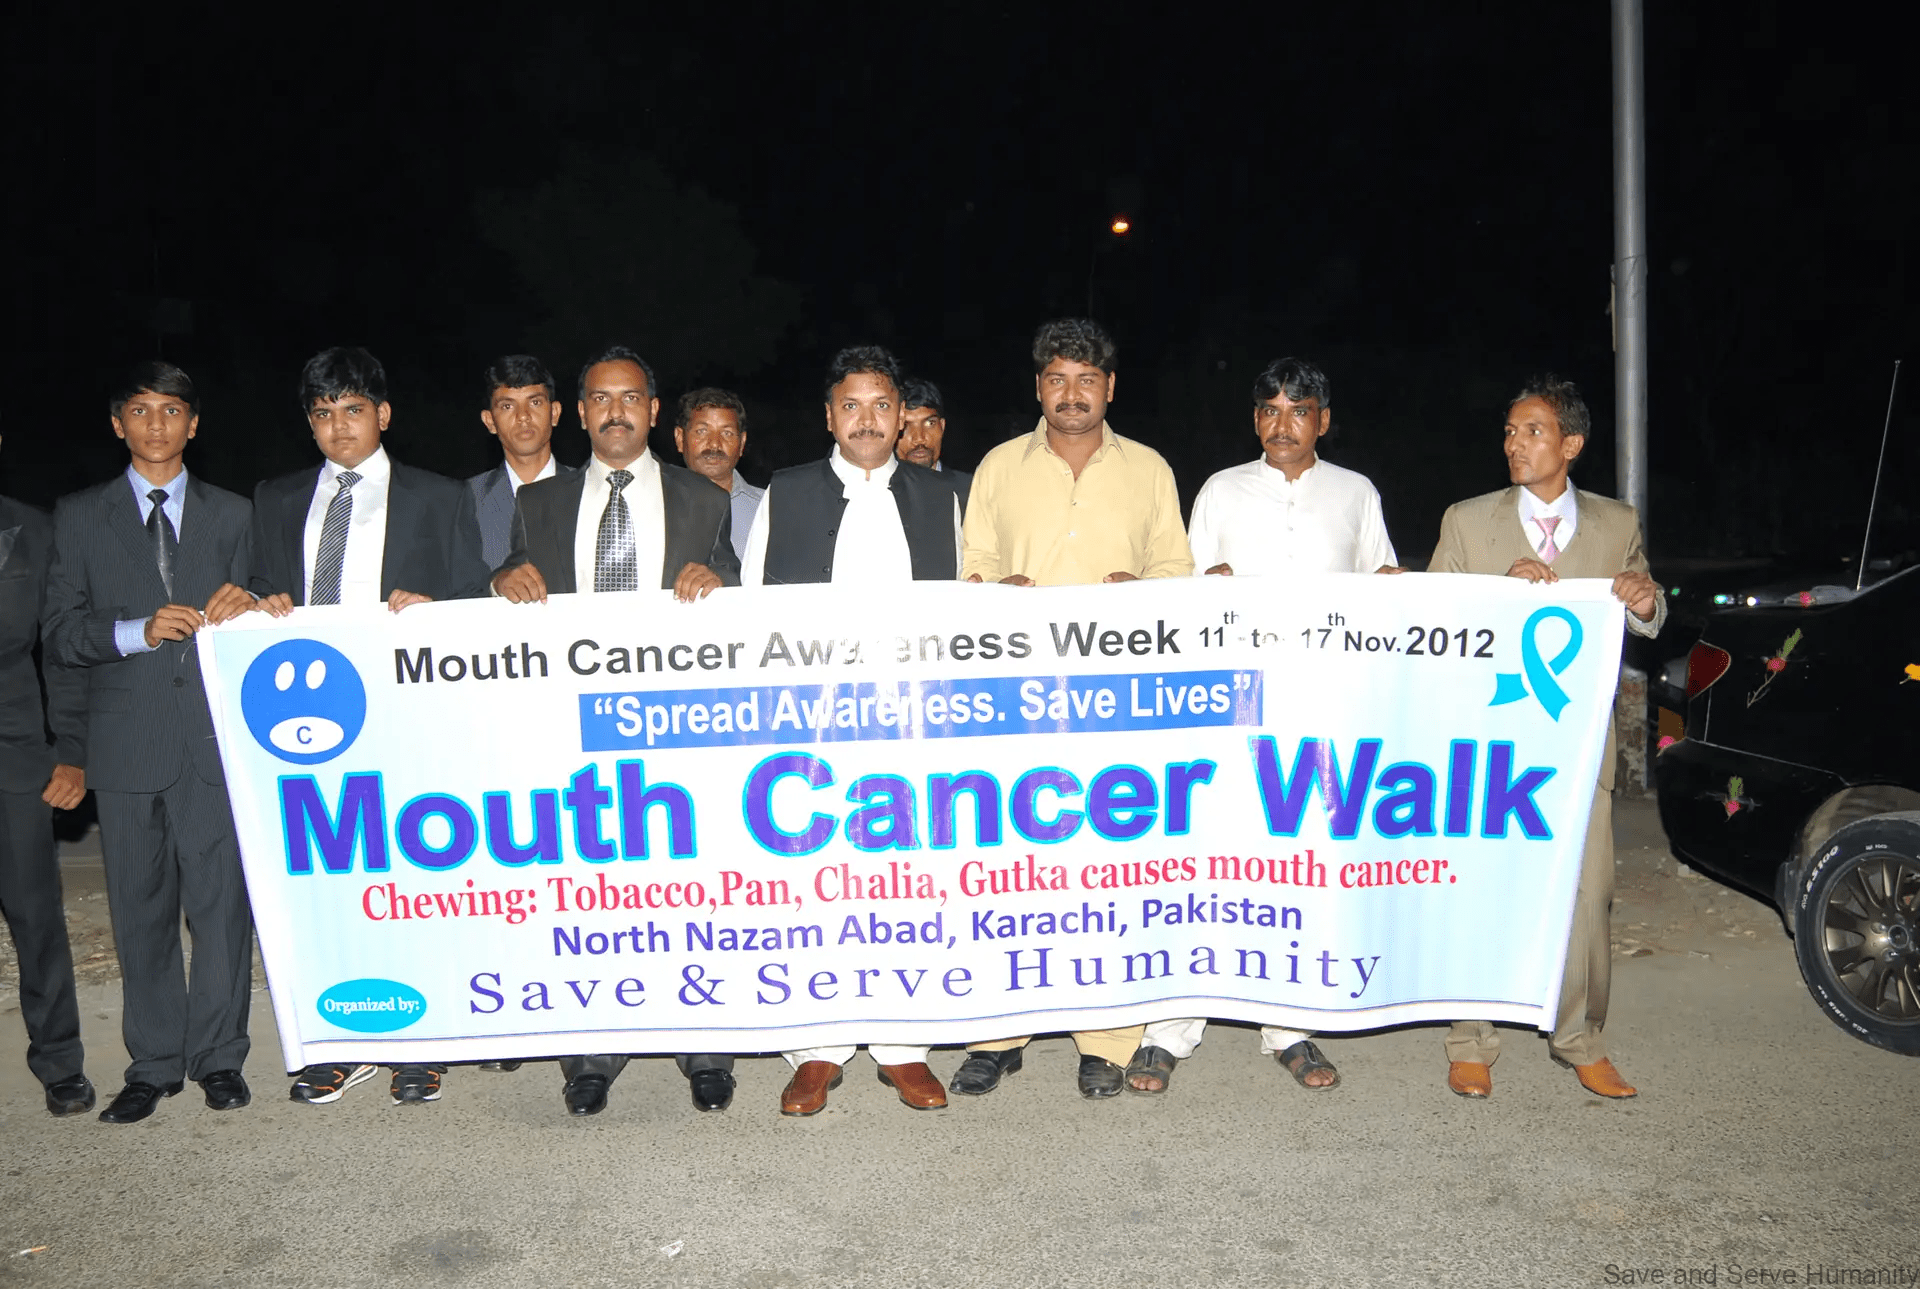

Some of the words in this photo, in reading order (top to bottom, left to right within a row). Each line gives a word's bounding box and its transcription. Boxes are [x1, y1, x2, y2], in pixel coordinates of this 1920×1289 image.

[394, 643, 549, 685] Mouth
[567, 639, 745, 676] Cancer
[758, 632, 1033, 668] Aweness
[1049, 619, 1182, 657] Week
[296, 726, 313, 745] C
[594, 690, 760, 746] “Spread
[1019, 680, 1117, 721] Save
[1130, 673, 1251, 718] Lives”
[277, 758, 698, 877] Mouth
[741, 750, 1218, 858] Cancer
[1247, 734, 1558, 842] Walk
[362, 878, 537, 925] Chewing:
[814, 861, 948, 902] Chalia,
[959, 853, 1070, 898] Gutka
[1080, 856, 1197, 890] causes
[1207, 849, 1327, 888] mouth
[1339, 858, 1457, 889] cancer.
[553, 921, 671, 957] North
[685, 919, 823, 952] Nazam
[838, 911, 957, 950] Abad,
[972, 901, 1128, 941] Karachi,
[1142, 892, 1302, 931] Pakistan
[323, 996, 396, 1016] Organized
[397, 995, 421, 1015] by:
[469, 972, 646, 1014] Save
[678, 964, 725, 1007] &
[757, 963, 973, 1004] Serve
[1004, 940, 1381, 999] Humanity
